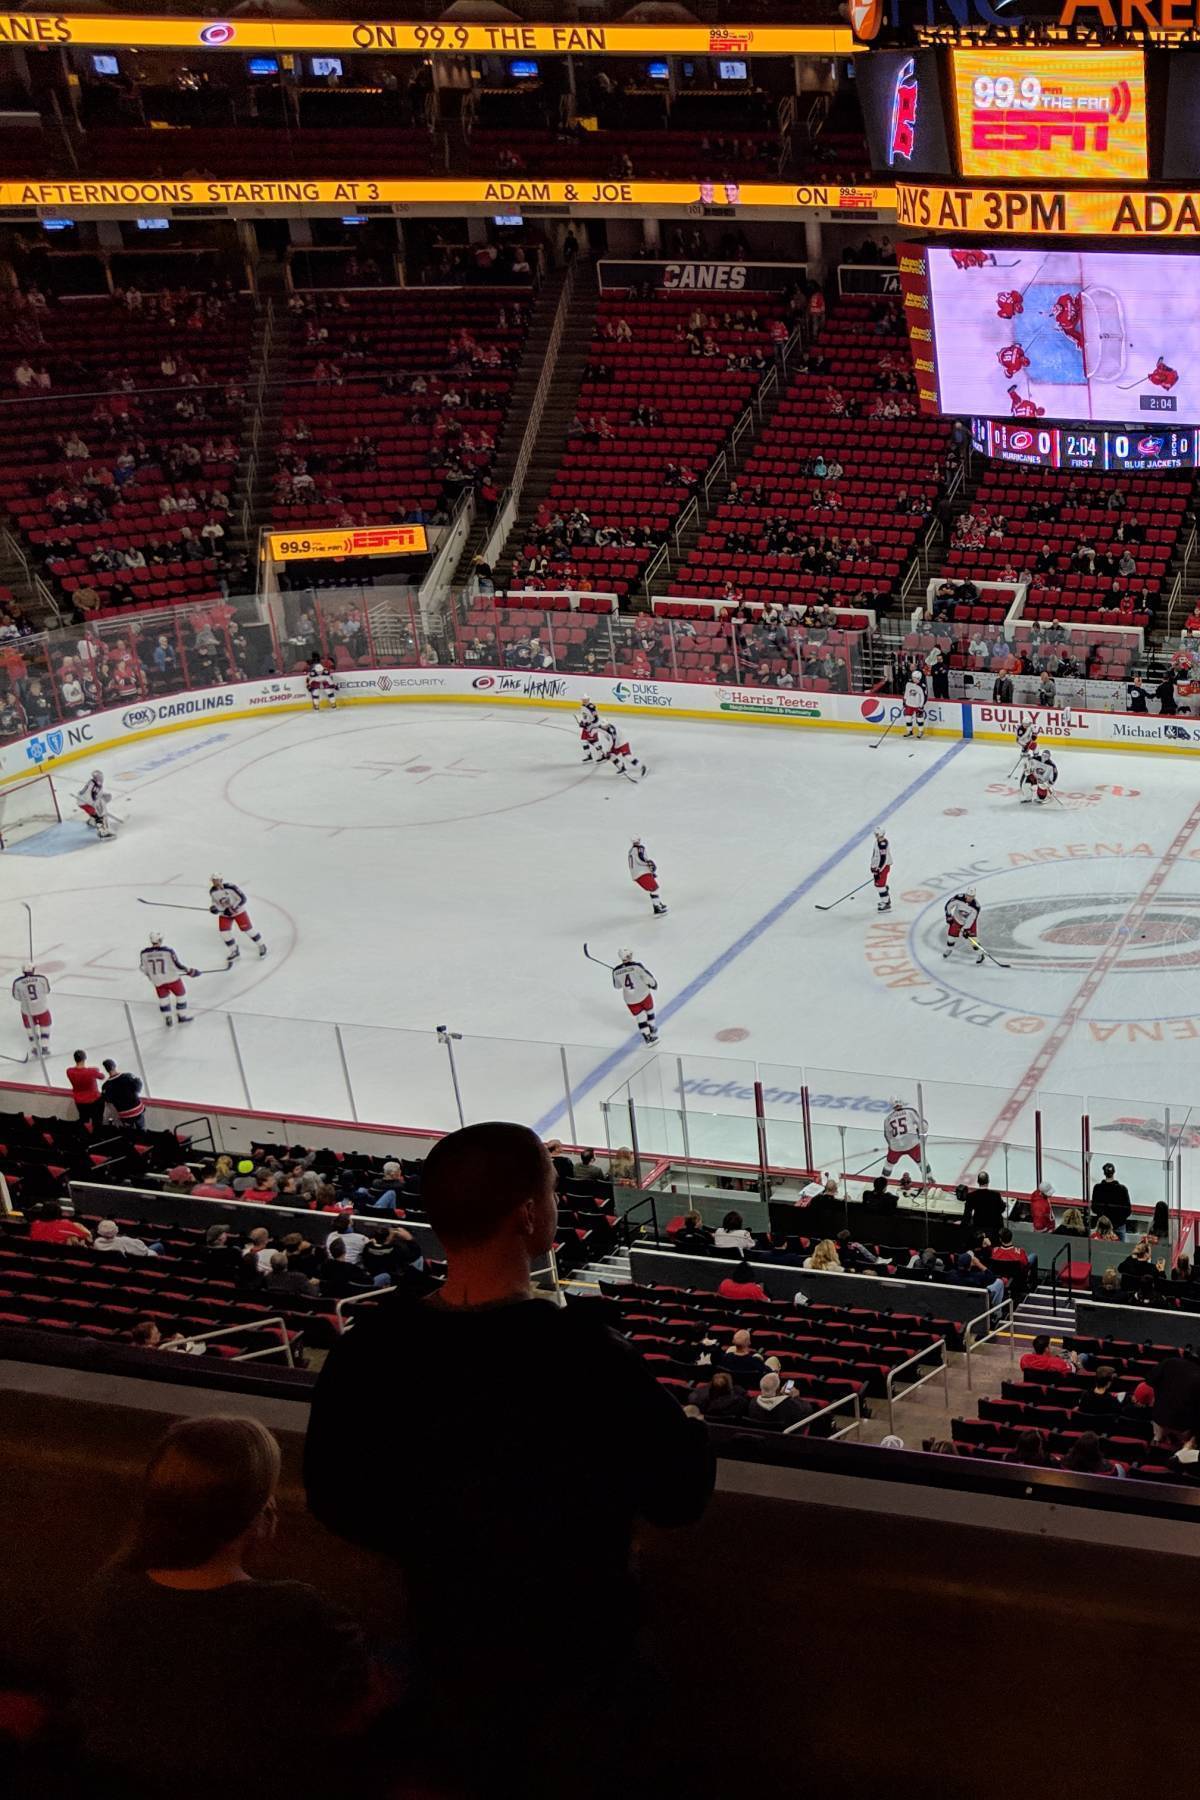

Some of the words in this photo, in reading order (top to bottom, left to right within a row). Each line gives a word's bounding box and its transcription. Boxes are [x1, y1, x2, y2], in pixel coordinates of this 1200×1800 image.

[353, 24, 397, 48] ON
[414, 26, 469, 49] 99.9
[485, 28, 537, 50] THE
[553, 28, 606, 50] FAN
[973, 76, 1041, 109] 99.9
[1042, 96, 1073, 108] THE
[972, 111, 1109, 150] ESPN
[22, 184, 193, 203] AFTERNOONS
[207, 184, 320, 202] STARTING
[334, 183, 361, 201] AT
[367, 184, 380, 201] 3
[485, 184, 550, 202] ADAM
[564, 185, 580, 202] &
[591, 185, 632, 202] JOE
[796, 187, 828, 205] ON
[938, 192, 974, 229] AT
[983, 193, 1066, 231] 3PM
[1111, 194, 1199, 232] ADAM
[663, 265, 746, 290] CANES
[1150, 398, 1172, 410] 2:04
[1038, 432, 1050, 454] 0
[1067, 436, 1096, 456] 2:04
[1115, 436, 1129, 458] 0
[1180, 438, 1188, 453] 0
[1071, 459, 1093, 468] FIRST
[1124, 460, 1145, 469] BLUE
[1146, 459, 1182, 468] JACKETS
[280, 541, 310, 554] 99.9
[353, 529, 414, 548] ESPN
[336, 679, 376, 689] ECTOR
[632, 683, 658, 696] DUKE
[128, 710, 148, 722] FOX
[158, 694, 235, 719] CAROLINAS
[633, 695, 672, 707] ENERGY
[732, 692, 773, 705] Harris
[777, 695, 819, 709] Teeter
[890, 706, 942, 723] psi
[981, 708, 1040, 725] BULLY
[68, 725, 93, 746] NC
[1000, 724, 1071, 737] VINARDS
[1113, 724, 1162, 739] Michael
[919, 857, 1003, 892] PNC
[1007, 842, 1154, 867] ARENA
[864, 921, 932, 991] ARENA
[148, 959, 165, 975] 77
[624, 974, 634, 989] 4
[27, 984, 38, 1000] 9
[909, 986, 1008, 1029] PNC
